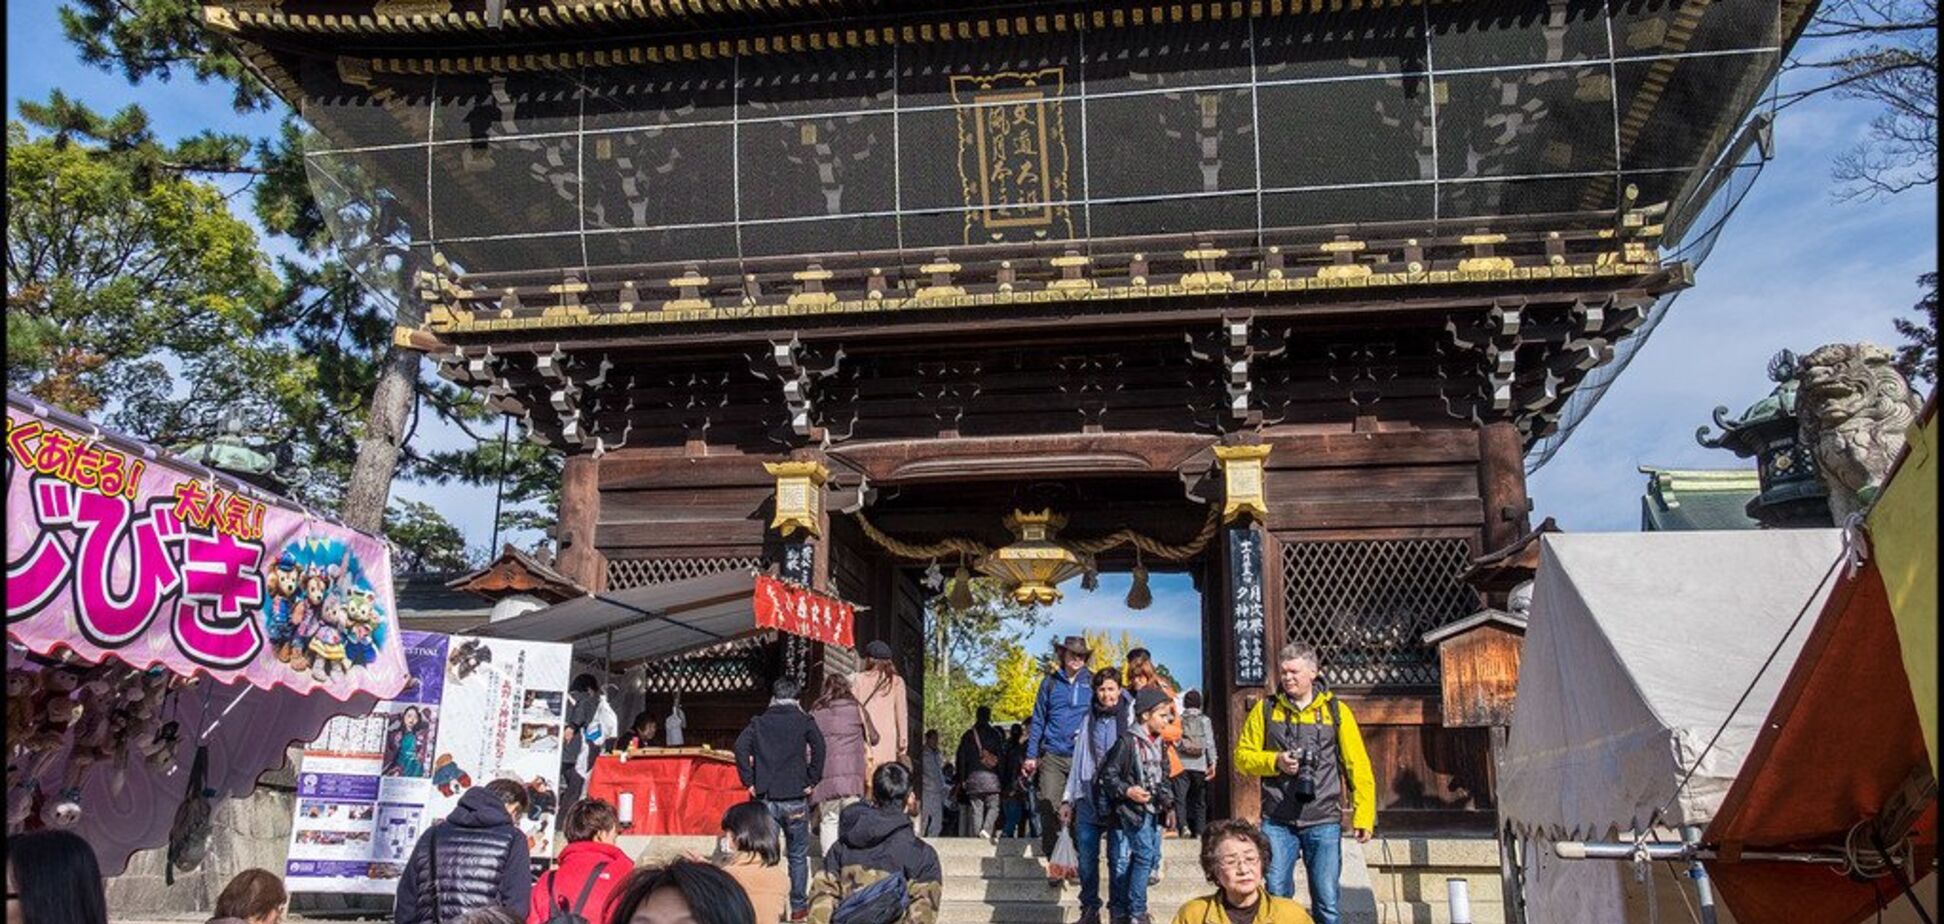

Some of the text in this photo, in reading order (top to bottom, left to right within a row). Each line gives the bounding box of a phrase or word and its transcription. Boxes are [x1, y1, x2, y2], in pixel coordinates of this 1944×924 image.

[7, 417, 144, 499] くあたる!
[173, 480, 266, 541] 大人気!
[1249, 585, 1264, 635] 月次祭
